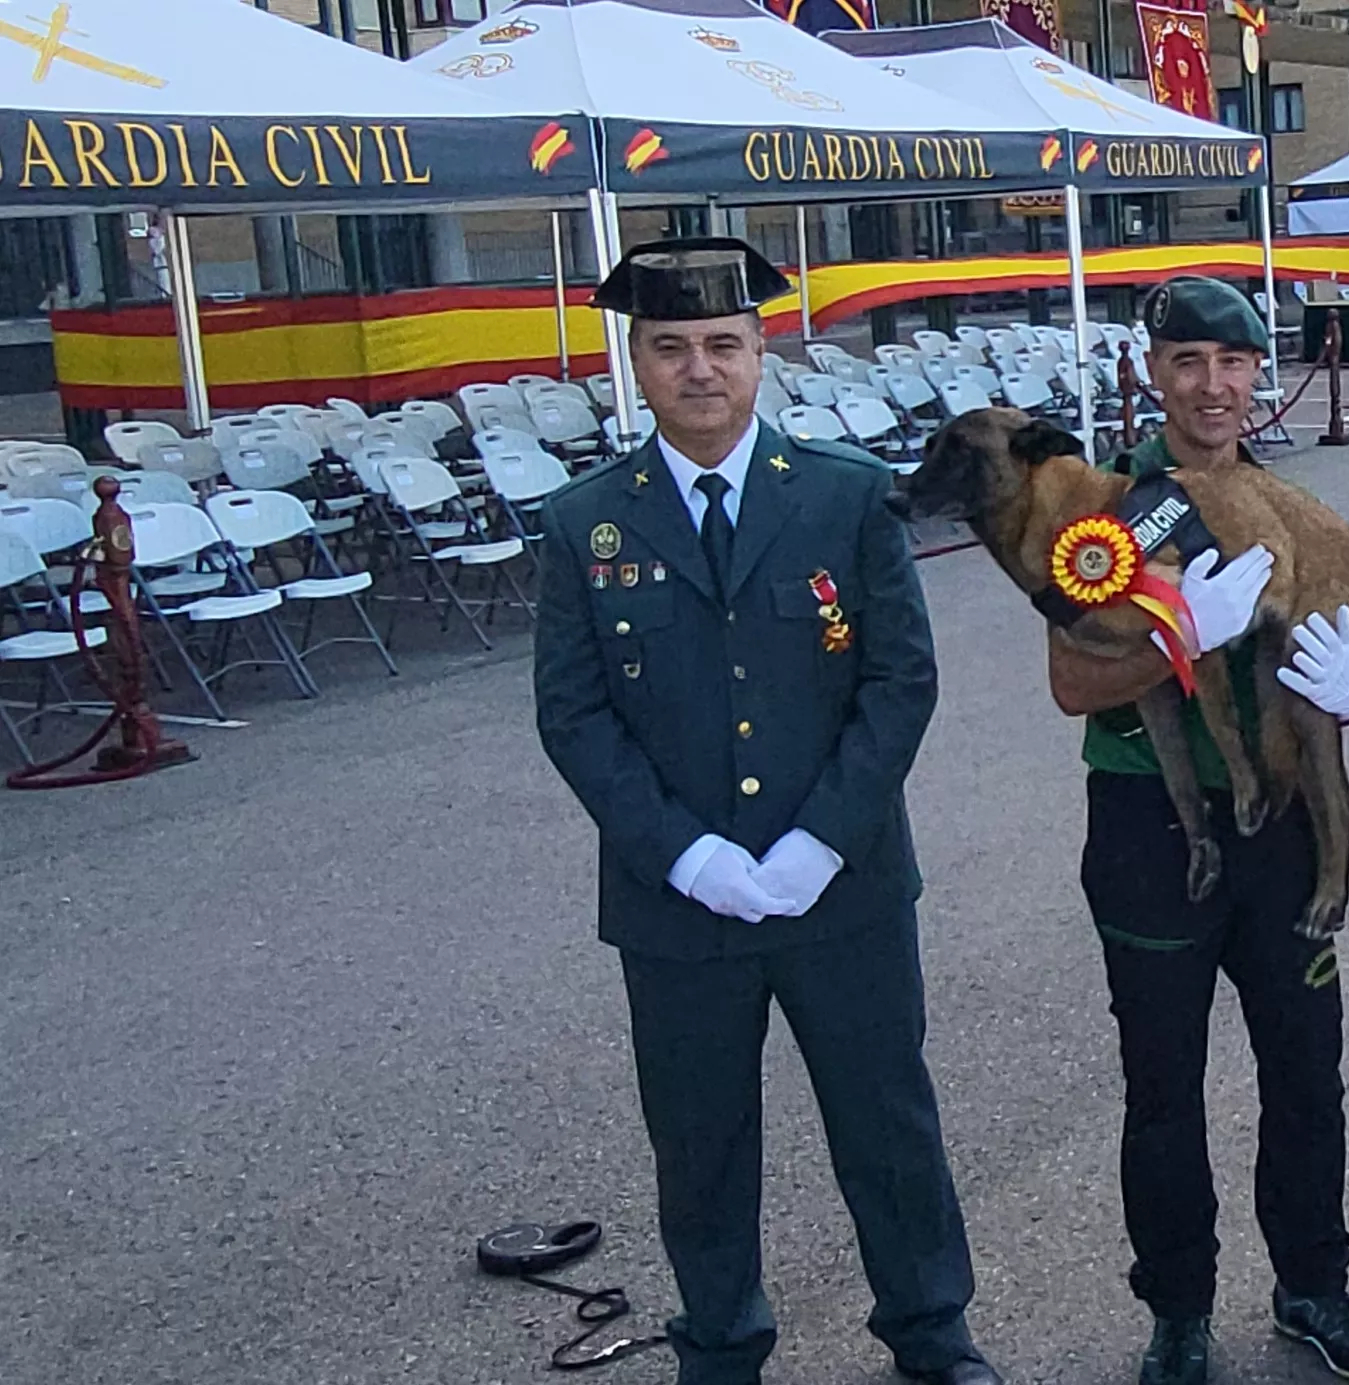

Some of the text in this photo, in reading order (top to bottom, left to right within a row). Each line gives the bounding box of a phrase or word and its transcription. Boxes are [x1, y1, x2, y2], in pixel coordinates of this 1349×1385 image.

[0, 119, 430, 187] ARDIA CIVIL
[745, 132, 995, 181] GUARDIA CIVIL
[1106, 142, 1245, 177] GUARDIA CIVIL
[1150, 497, 1190, 529] CIVIL
